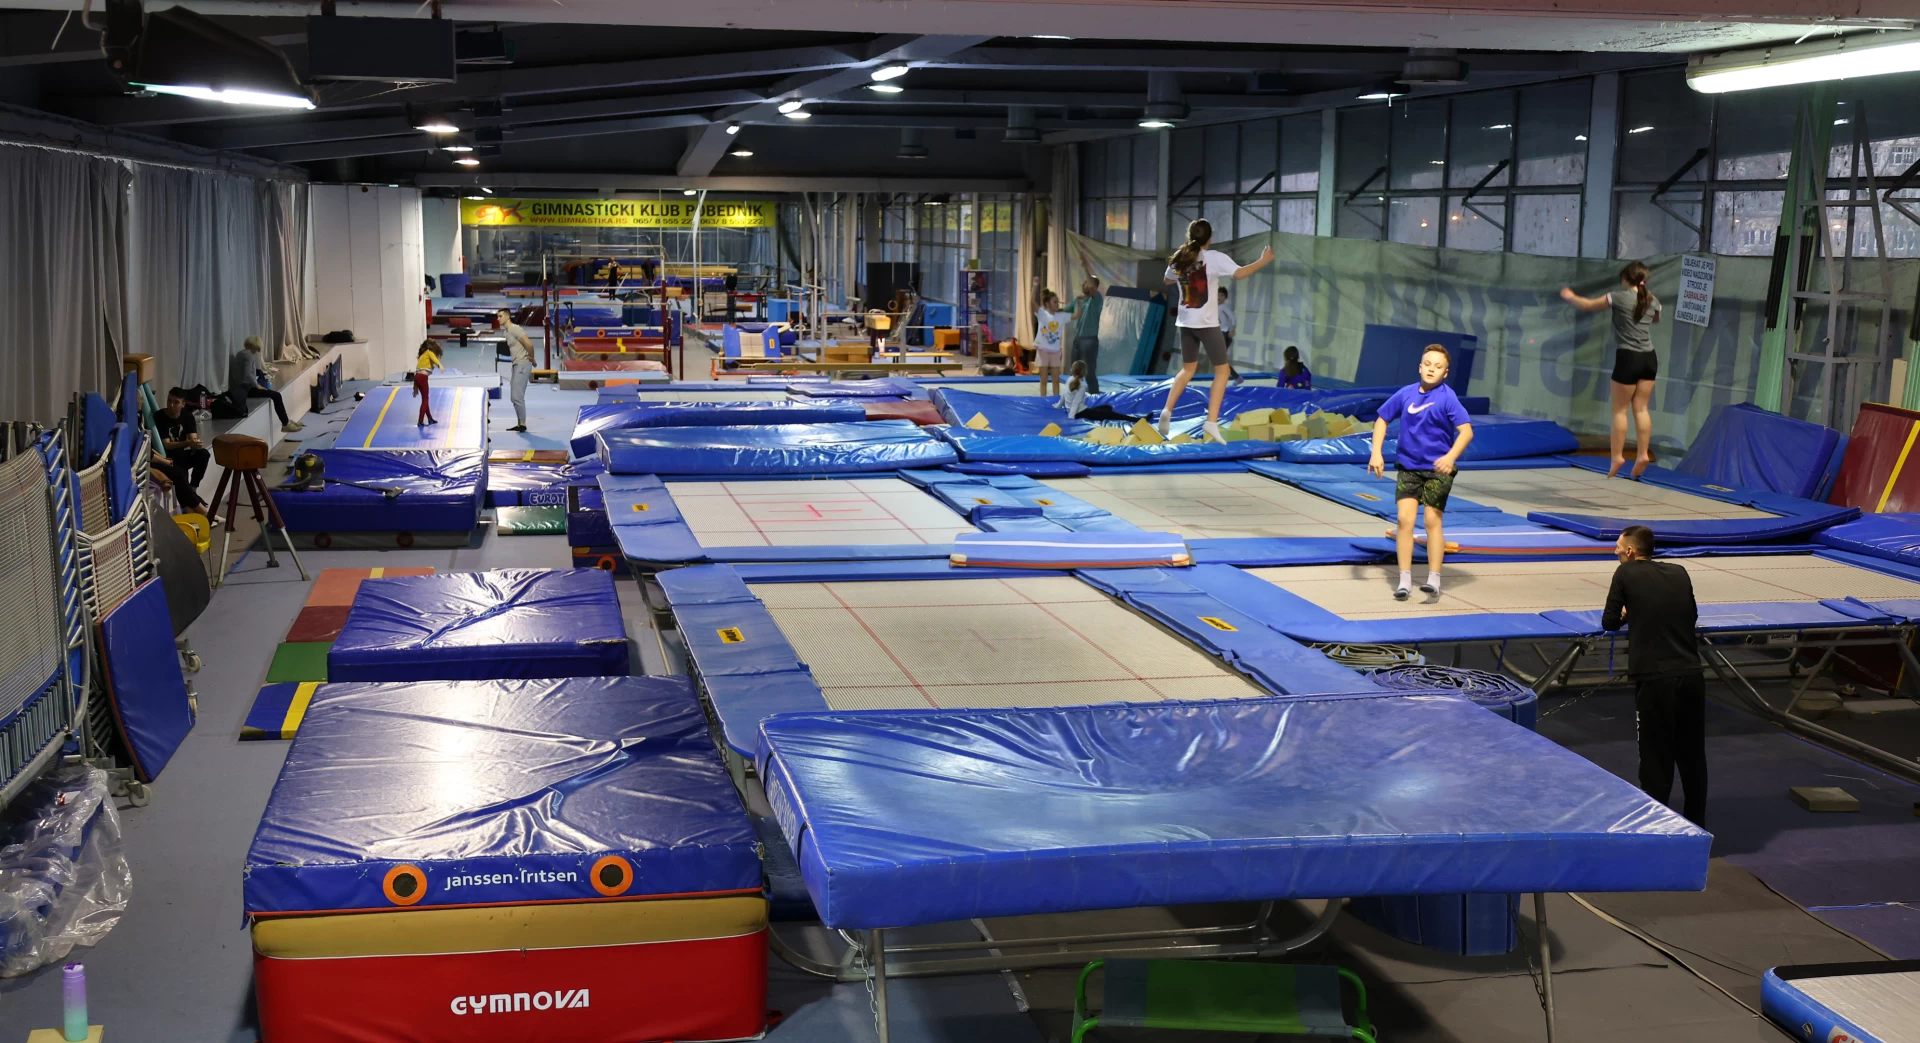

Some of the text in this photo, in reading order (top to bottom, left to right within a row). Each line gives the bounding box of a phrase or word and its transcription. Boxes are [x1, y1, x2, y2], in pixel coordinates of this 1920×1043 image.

[640, 204, 680, 217] KLUB
[686, 204, 763, 217] POBEDNIK
[450, 988, 590, 1015] GYMNOVA
